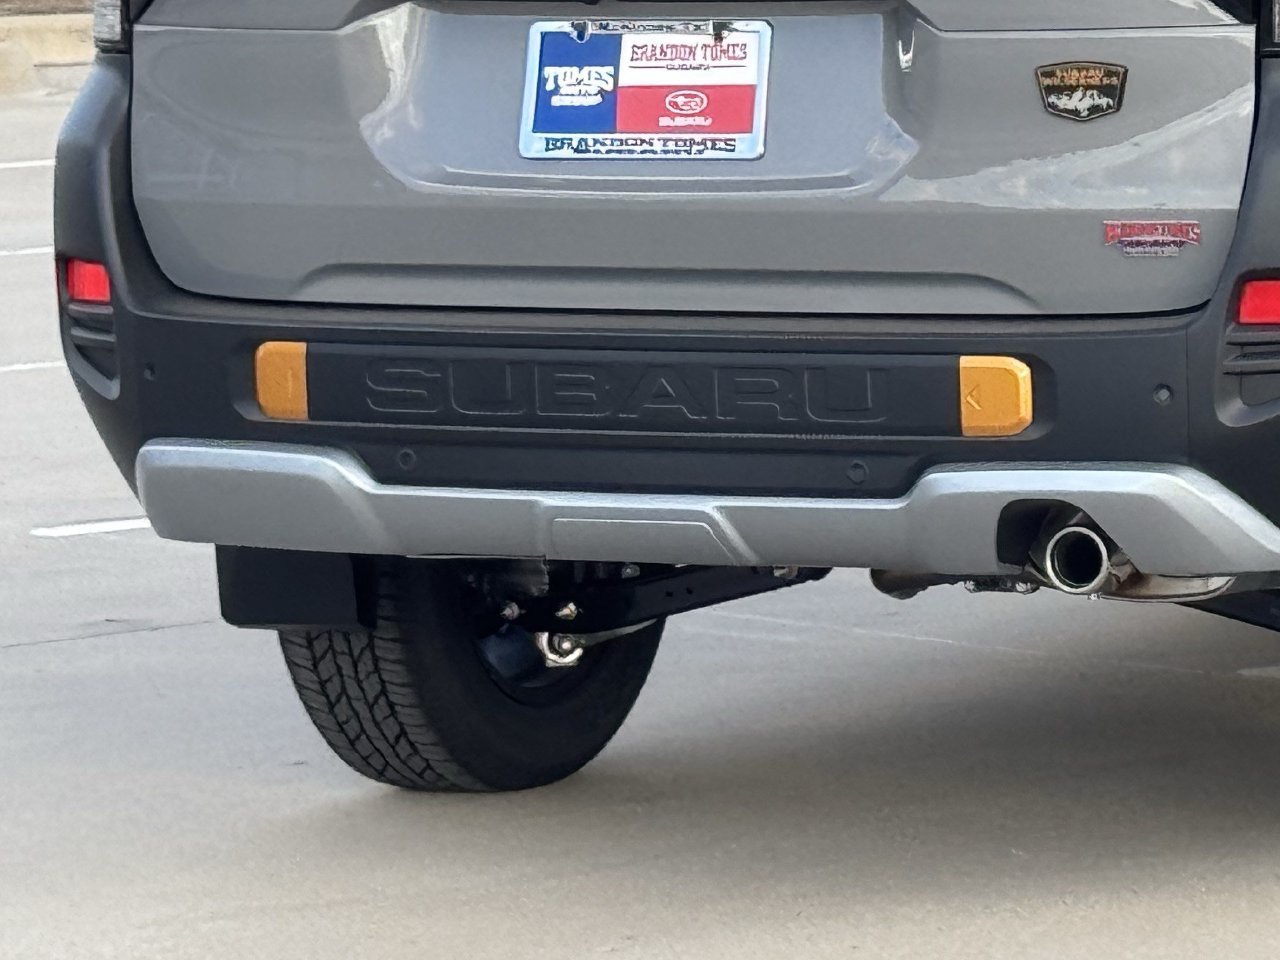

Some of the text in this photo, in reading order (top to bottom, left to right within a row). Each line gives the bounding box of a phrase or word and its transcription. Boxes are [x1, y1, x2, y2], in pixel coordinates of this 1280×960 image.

[543, 65, 616, 91] TOMES
[657, 137, 737, 154] TOMES
[365, 359, 888, 424] SUBARU
